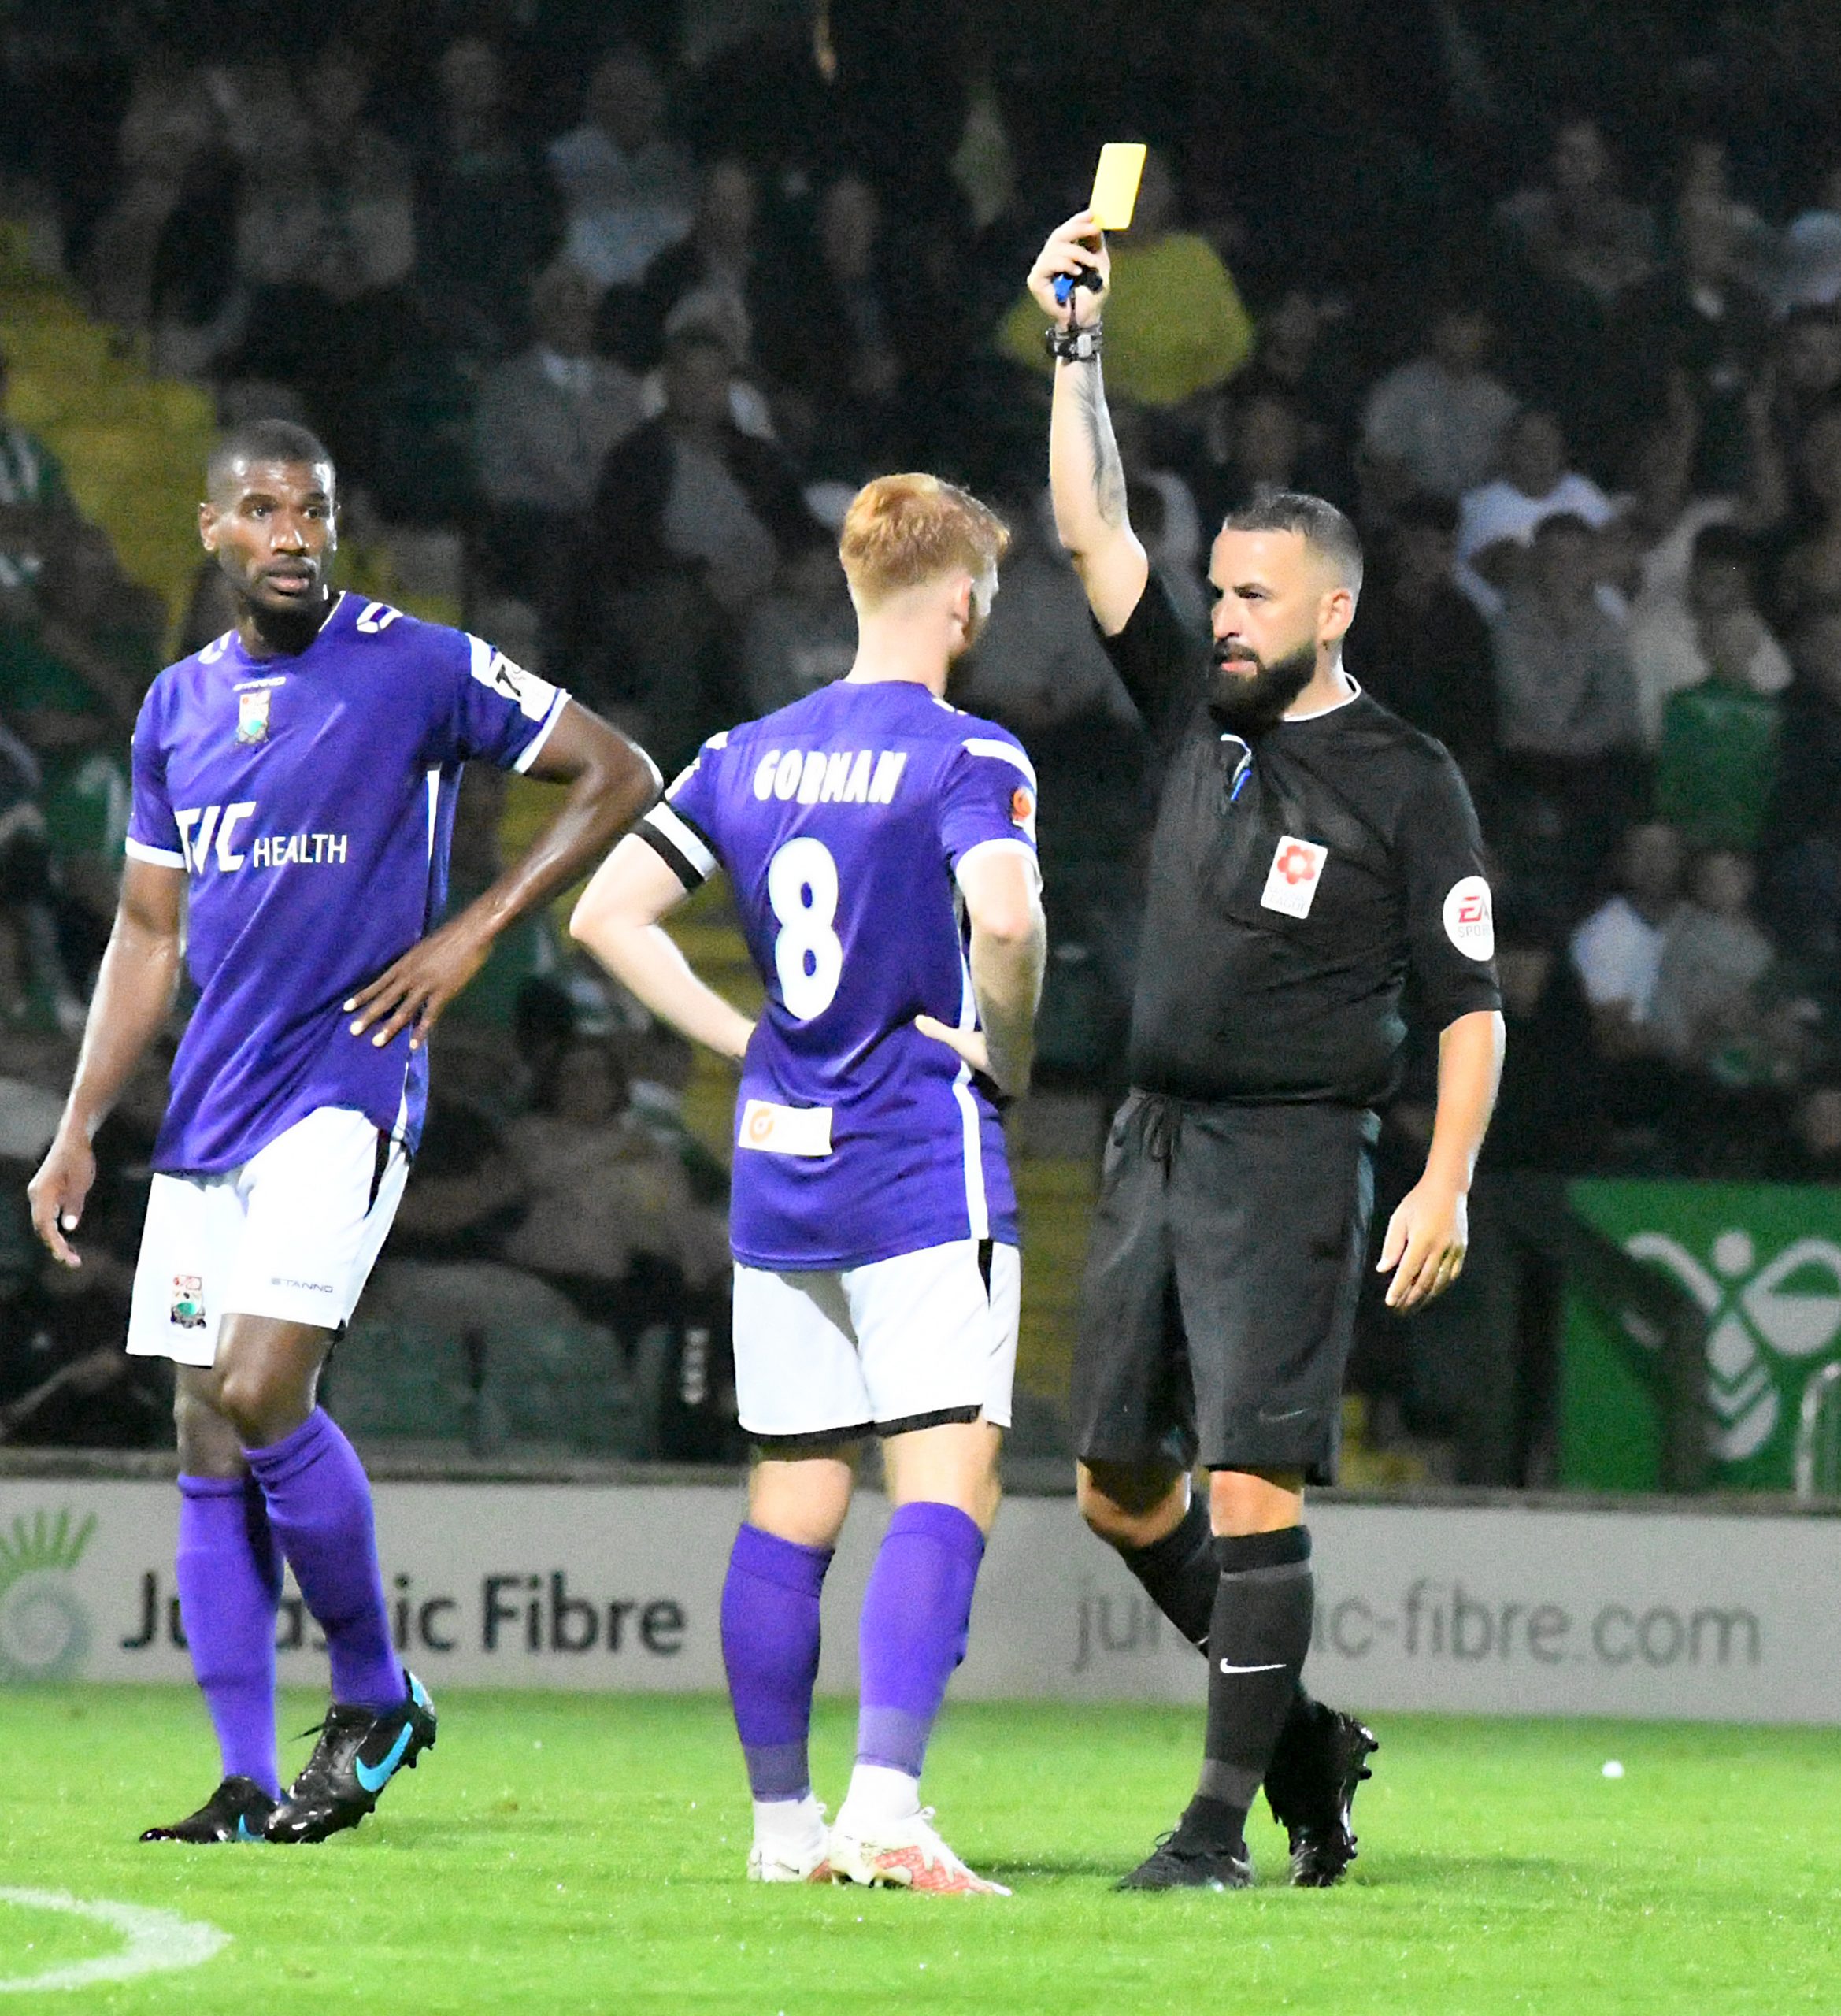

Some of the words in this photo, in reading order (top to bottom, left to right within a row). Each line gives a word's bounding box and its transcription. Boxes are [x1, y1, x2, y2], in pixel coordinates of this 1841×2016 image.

[753, 748, 907, 805] GORMAN
[253, 833, 348, 869] HEALTH
[768, 836, 844, 1021] 8
[1458, 895, 1491, 924] EA
[270, 1277, 334, 1294] STANNO
[482, 1569, 686, 1656] Fibre
